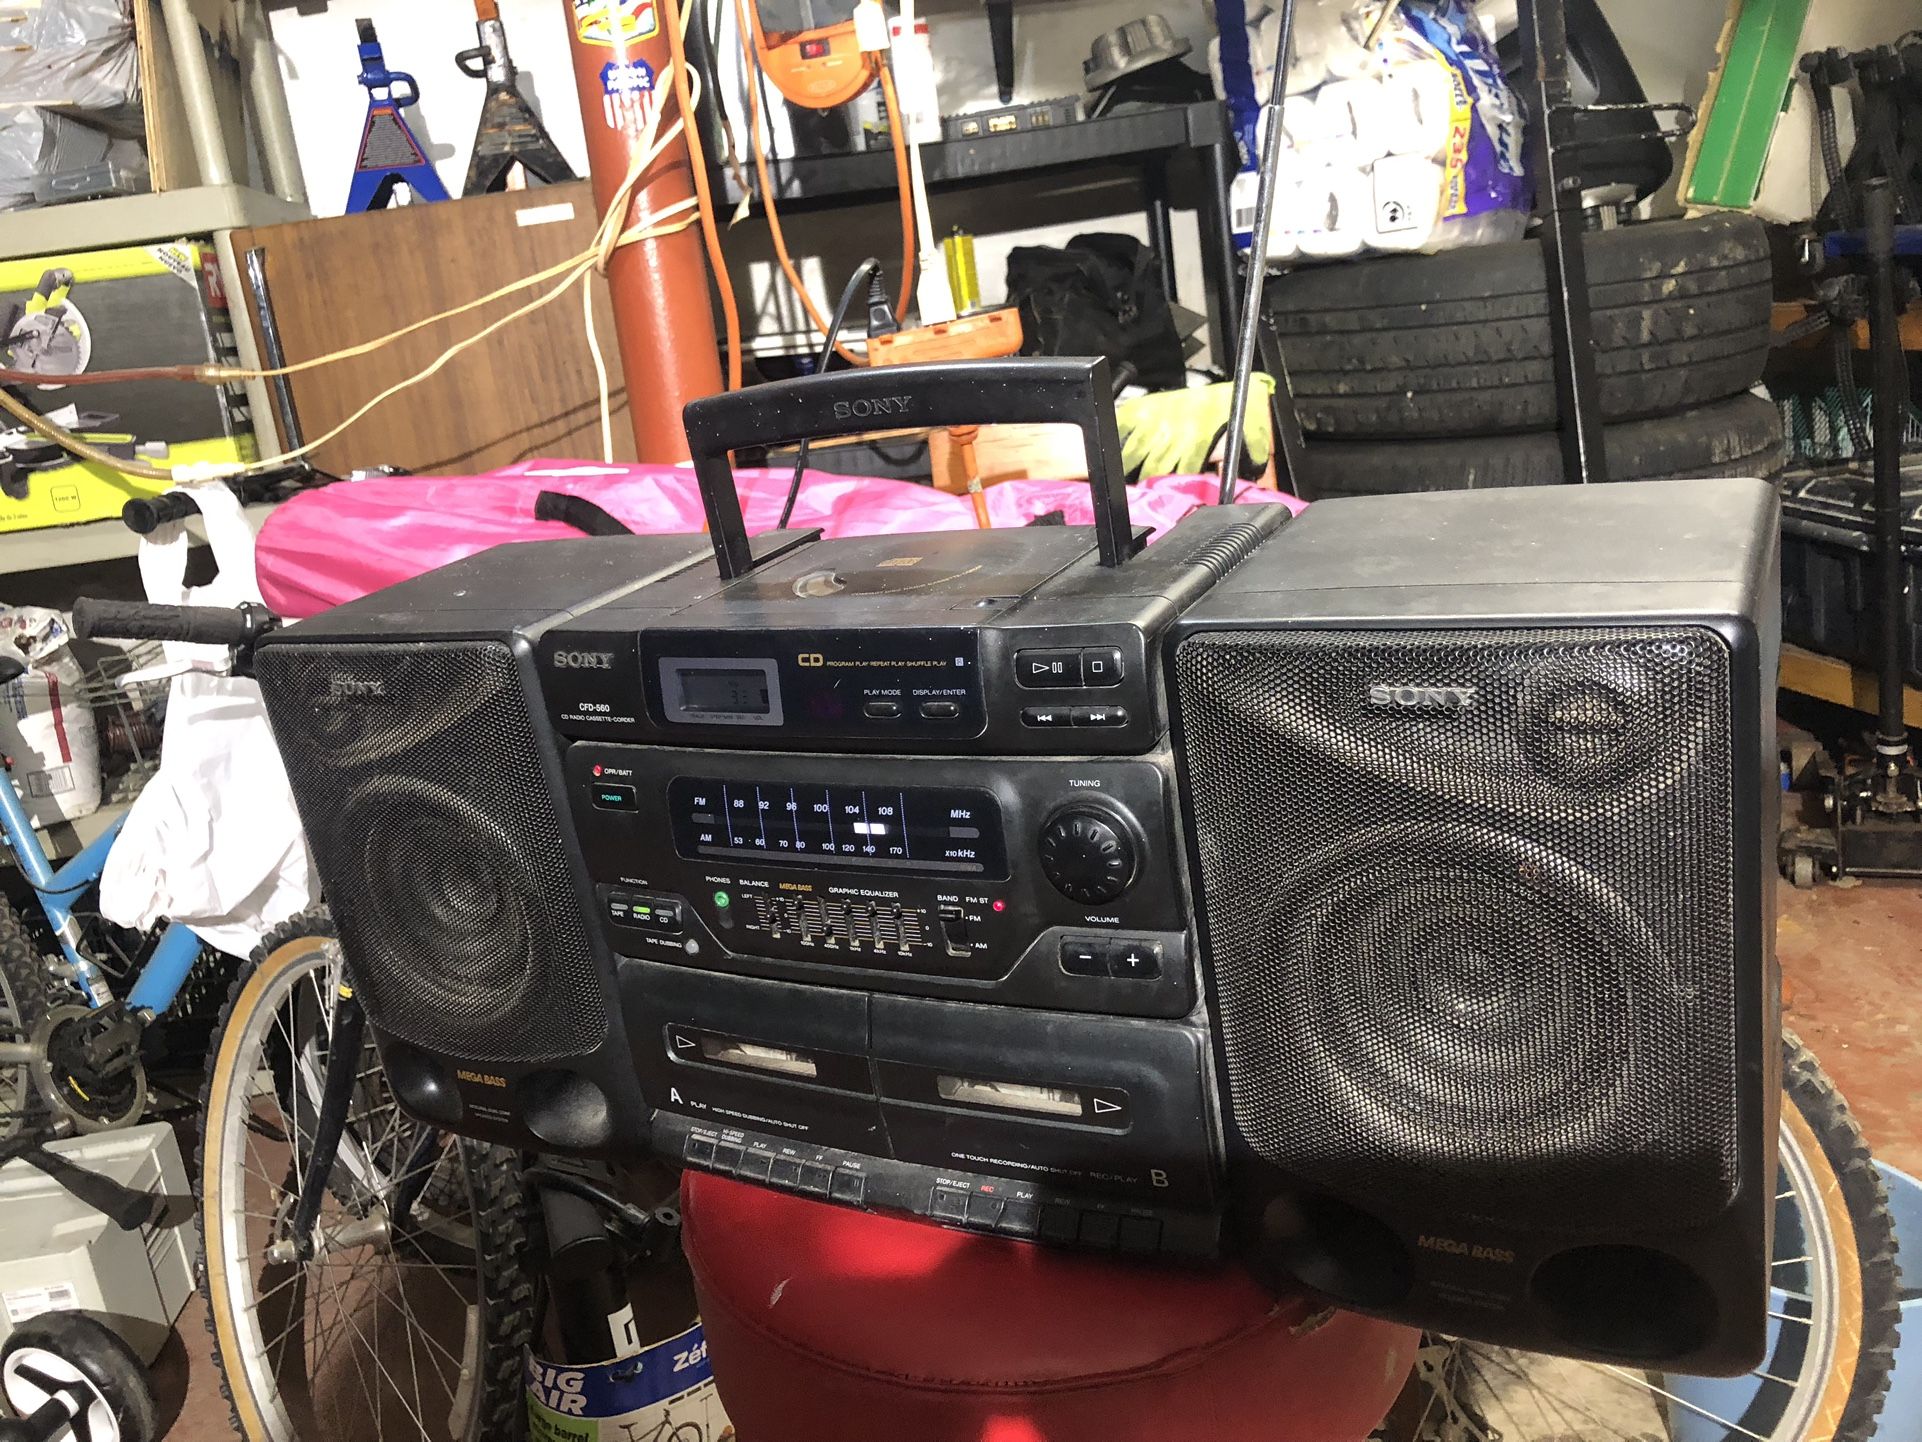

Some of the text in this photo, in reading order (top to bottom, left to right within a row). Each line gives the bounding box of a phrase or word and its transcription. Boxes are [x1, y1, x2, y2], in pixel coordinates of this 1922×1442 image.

[834, 396, 912, 419] SONY
[553, 651, 614, 669] SONY
[798, 654, 823, 666] CD
[1369, 686, 1478, 706] SONY
[579, 703, 610, 712] CFD-560
[604, 768, 633, 777] OPR/BATT
[601, 794, 622, 802] POWER
[694, 797, 971, 819] FM 88 92 96 100 104 108 MHz
[700, 833, 712, 842] AM
[734, 837, 744, 845] 53
[755, 838, 765, 846] 60
[778, 840, 789, 848] 70
[795, 841, 806, 849] 80
[822, 842, 835, 850] 100
[842, 844, 855, 852] 120
[862, 845, 876, 853] 140
[889, 846, 903, 855] 170
[620, 876, 648, 885] FUNCTION
[705, 875, 731, 884] PHONES
[739, 879, 769, 888] BALANCE
[779, 883, 797, 891] MEGA
[828, 887, 899, 898] GRAPHIC EQUALIZER
[611, 910, 624, 918] TAPE
[633, 913, 651, 921] RADIO
[1085, 915, 1119, 924] VOLUME
[646, 937, 659, 945] TAPE
[457, 1069, 506, 1088] MEGA BASS
[670, 1087, 683, 1104] A
[753, 1141, 767, 1149] PLAY
[966, 1154, 989, 1163] TOUCH
[842, 1160, 861, 1170] PAUSE
[936, 1177, 970, 1189] STOP/EJECT
[1089, 1168, 1169, 1187] REC/PLAY B
[980, 1184, 994, 1193] REC
[1017, 1191, 1034, 1200] PLAY
[1418, 1234, 1515, 1263] MEGA BASS
[528, 1361, 586, 1394] BIG
[530, 1383, 588, 1416] AIR
